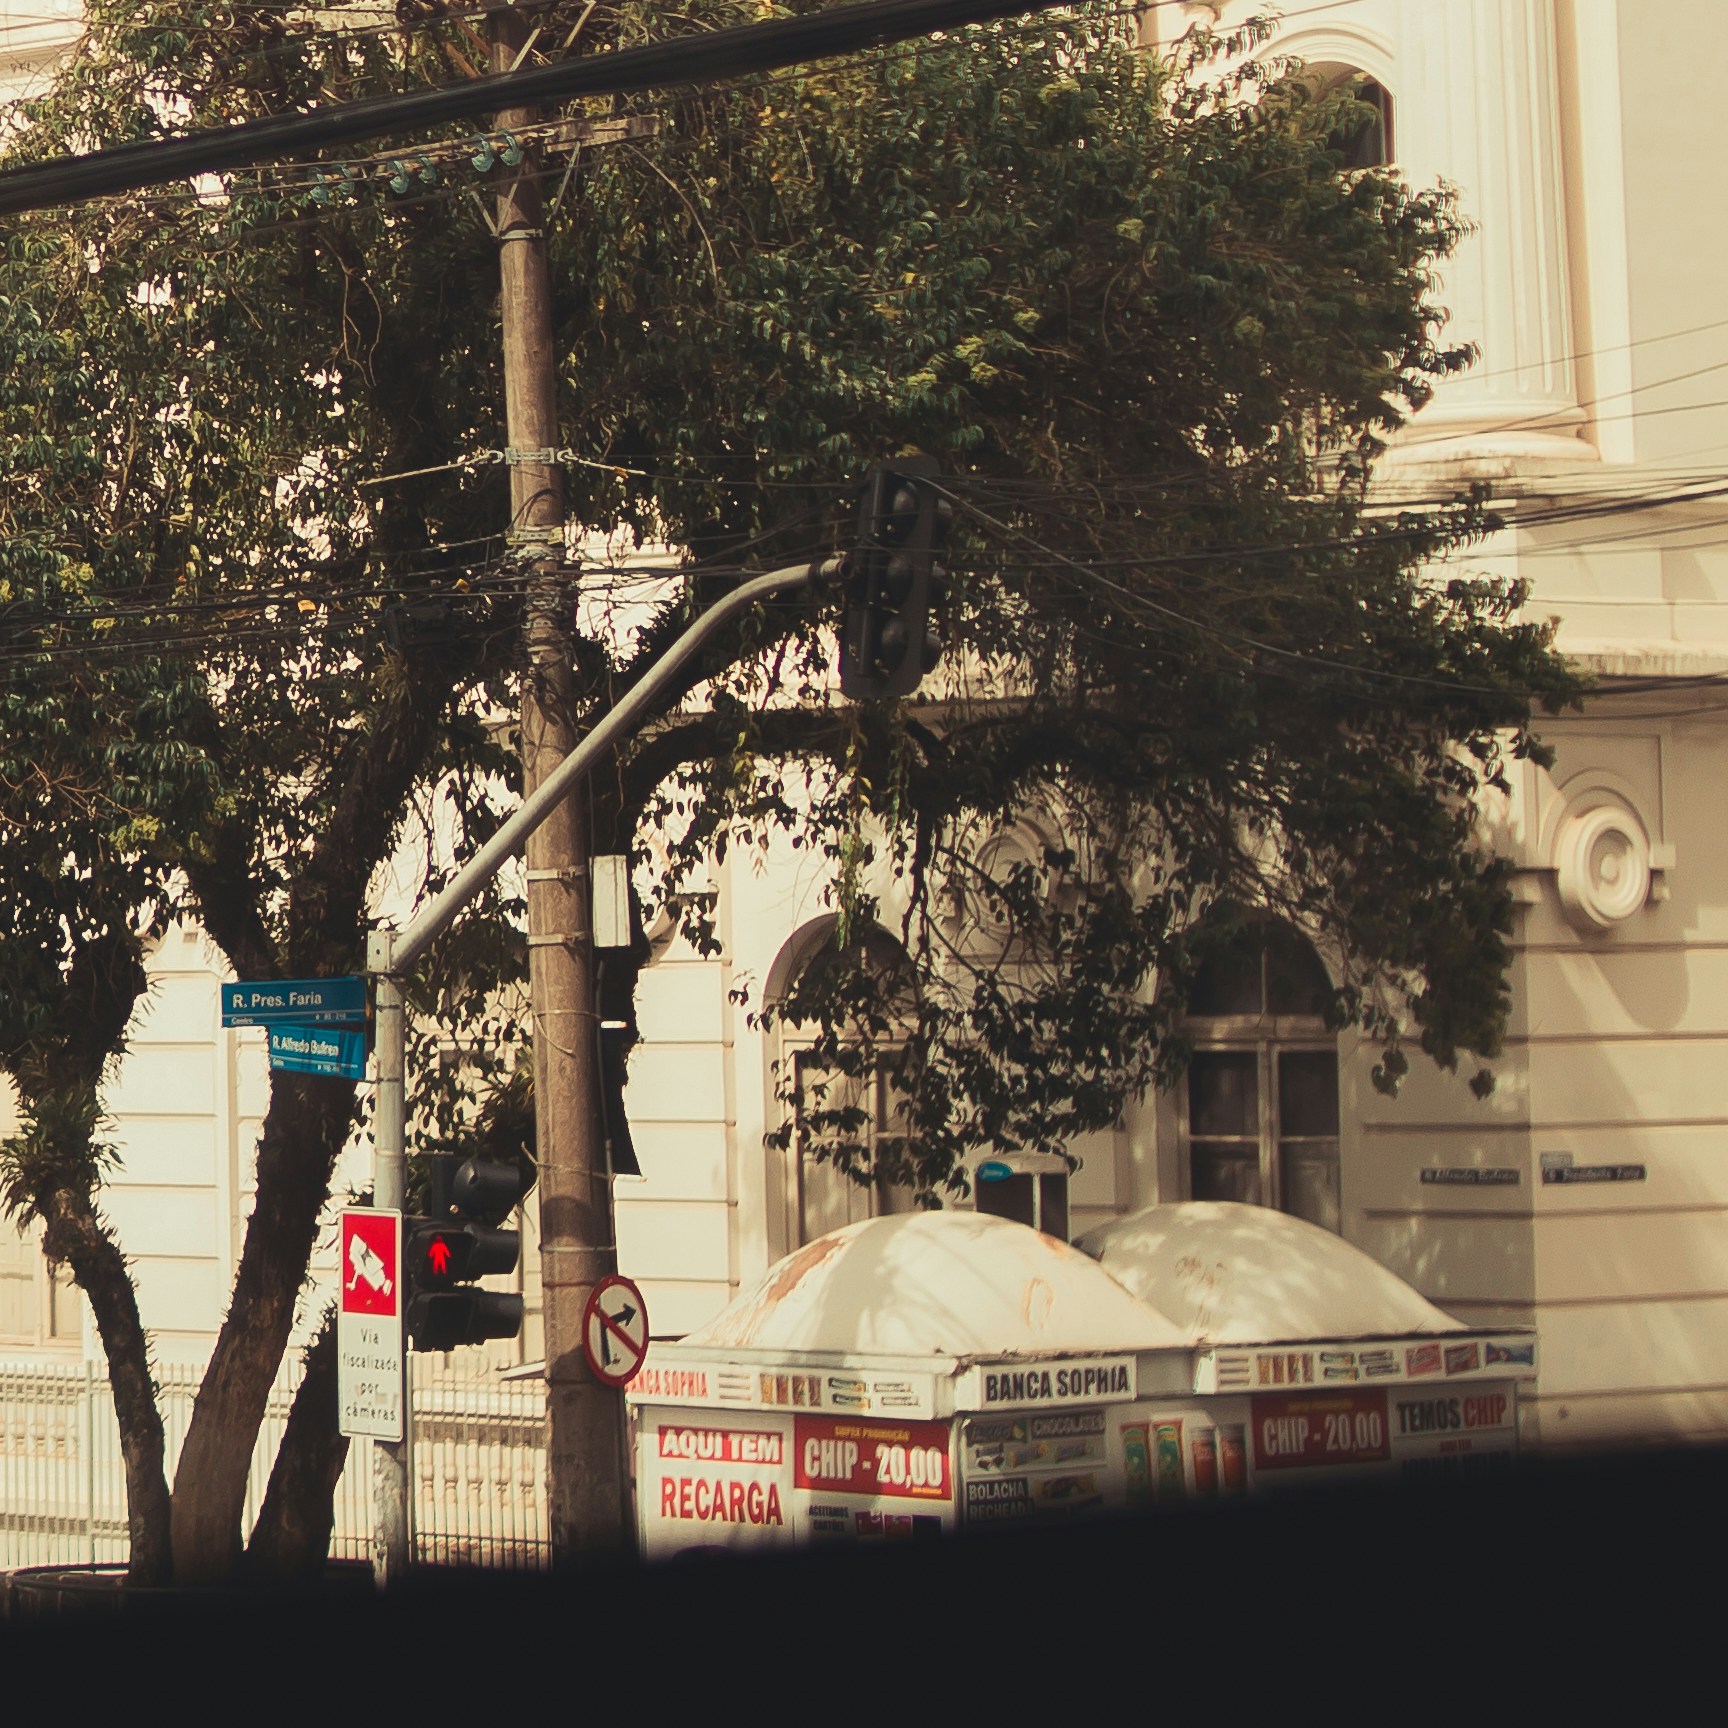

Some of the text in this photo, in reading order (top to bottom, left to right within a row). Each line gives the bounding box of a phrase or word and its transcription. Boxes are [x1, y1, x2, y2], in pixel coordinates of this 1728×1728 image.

[232, 991, 322, 1008] R. Pres. Faria
[281, 1036, 309, 1053] Alfredo
[361, 1329, 379, 1345] Via
[343, 1352, 398, 1372] fiscalizada
[664, 1370, 708, 1398] SOPHIA
[985, 1365, 1129, 1402] BANCA SOPHIA
[346, 1401, 396, 1422] câmeras
[1397, 1393, 1506, 1433] TEMOS CHIP
[661, 1428, 780, 1463] AQUI TEM
[1262, 1416, 1308, 1457] CHIP
[1324, 1411, 1382, 1453] 20,00
[805, 1437, 858, 1480] CHIP
[875, 1442, 943, 1489] 20,00
[661, 1476, 783, 1525] RECARGA
[968, 1481, 1025, 1501] BOLACHA
